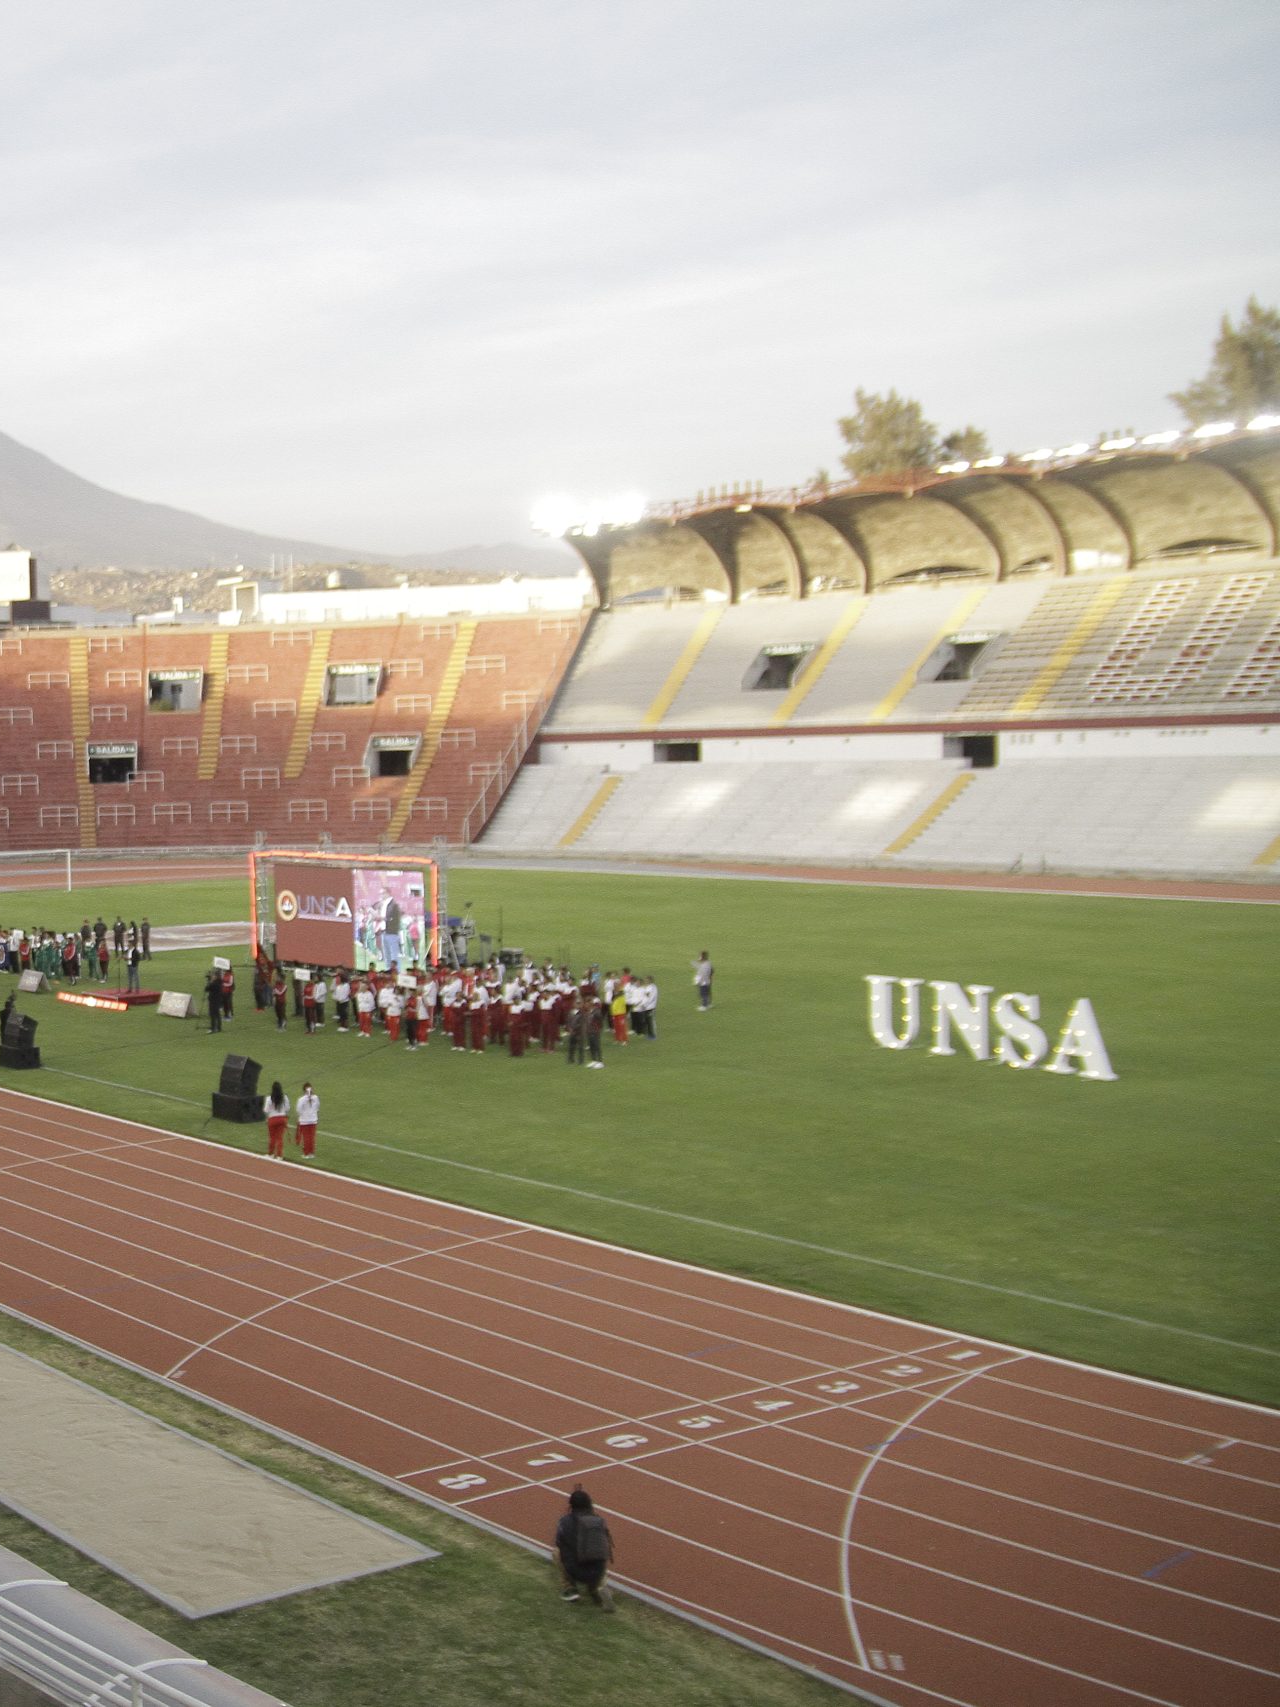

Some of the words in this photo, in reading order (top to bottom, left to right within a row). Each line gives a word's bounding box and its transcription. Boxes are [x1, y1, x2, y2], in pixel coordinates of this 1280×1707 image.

[96, 745, 126, 754] SALIDA
[297, 895, 353, 918] UNSA
[863, 975, 1119, 1081] UNSA
[947, 1350, 982, 1361] 1
[880, 1364, 925, 1377] 2
[817, 1381, 862, 1395] 3
[753, 1400, 794, 1412] 4
[678, 1414, 725, 1430] 5
[604, 1433, 649, 1450] 6
[527, 1452, 573, 1467] 7
[438, 1473, 489, 1493] 8
